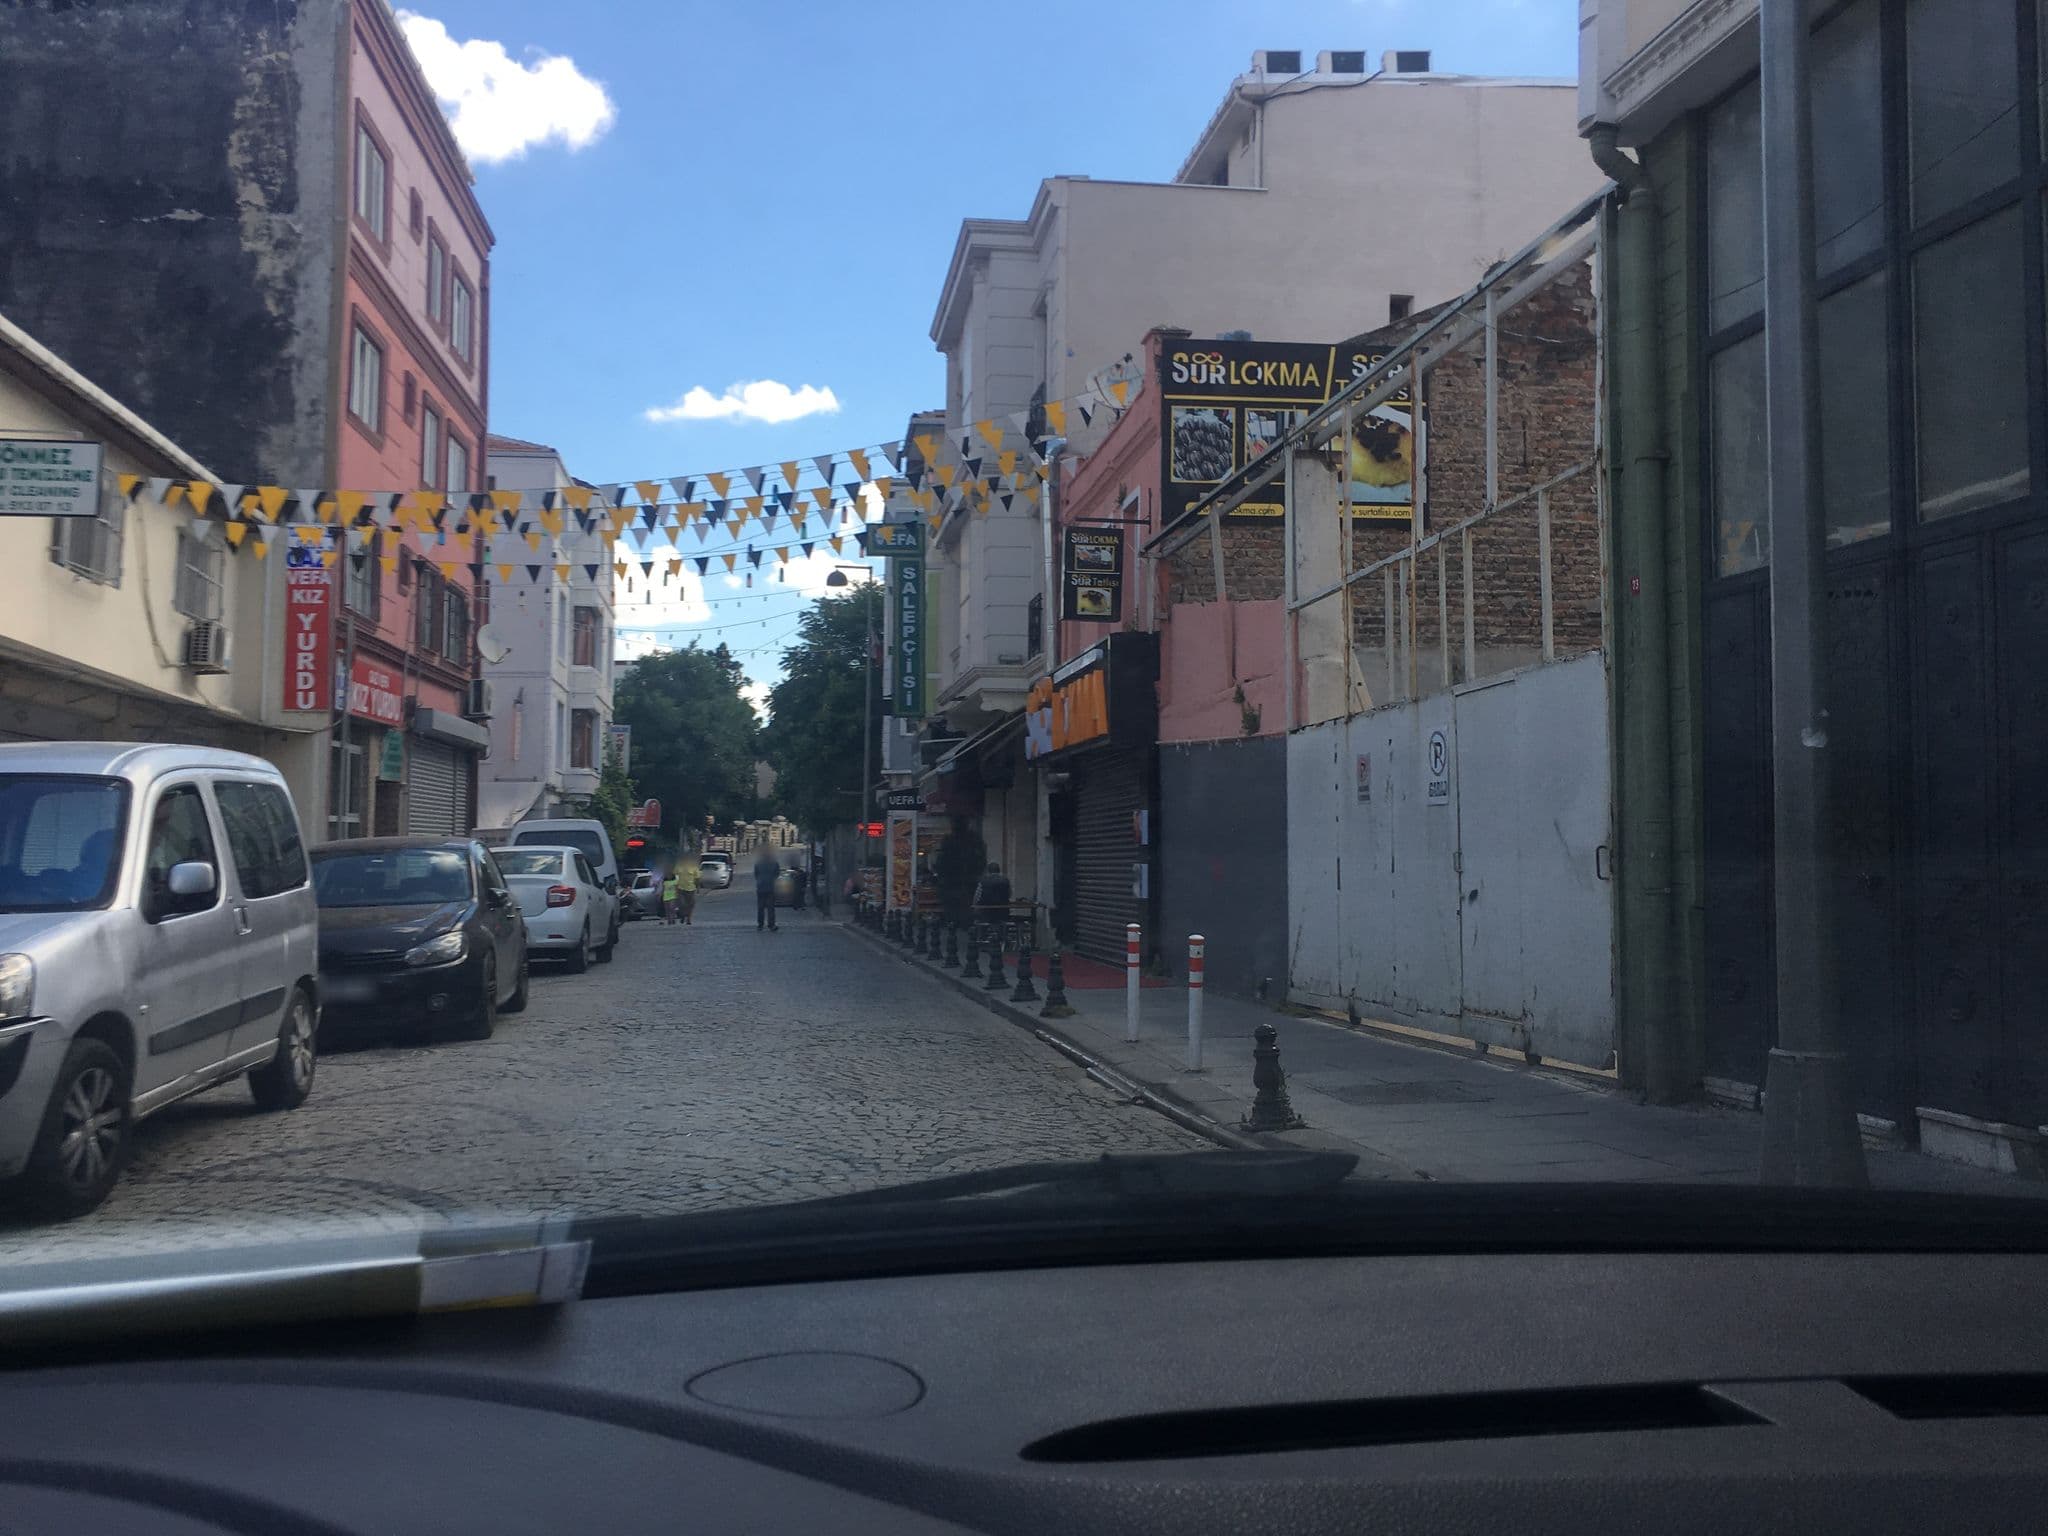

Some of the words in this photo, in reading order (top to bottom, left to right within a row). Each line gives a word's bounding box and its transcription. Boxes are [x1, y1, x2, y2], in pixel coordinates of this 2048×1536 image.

[1230, 359, 1320, 387] LOKMA
[0, 443, 72, 465] ÖNMEZ
[292, 588, 325, 603] KIZ
[296, 612, 317, 709] YURDU
